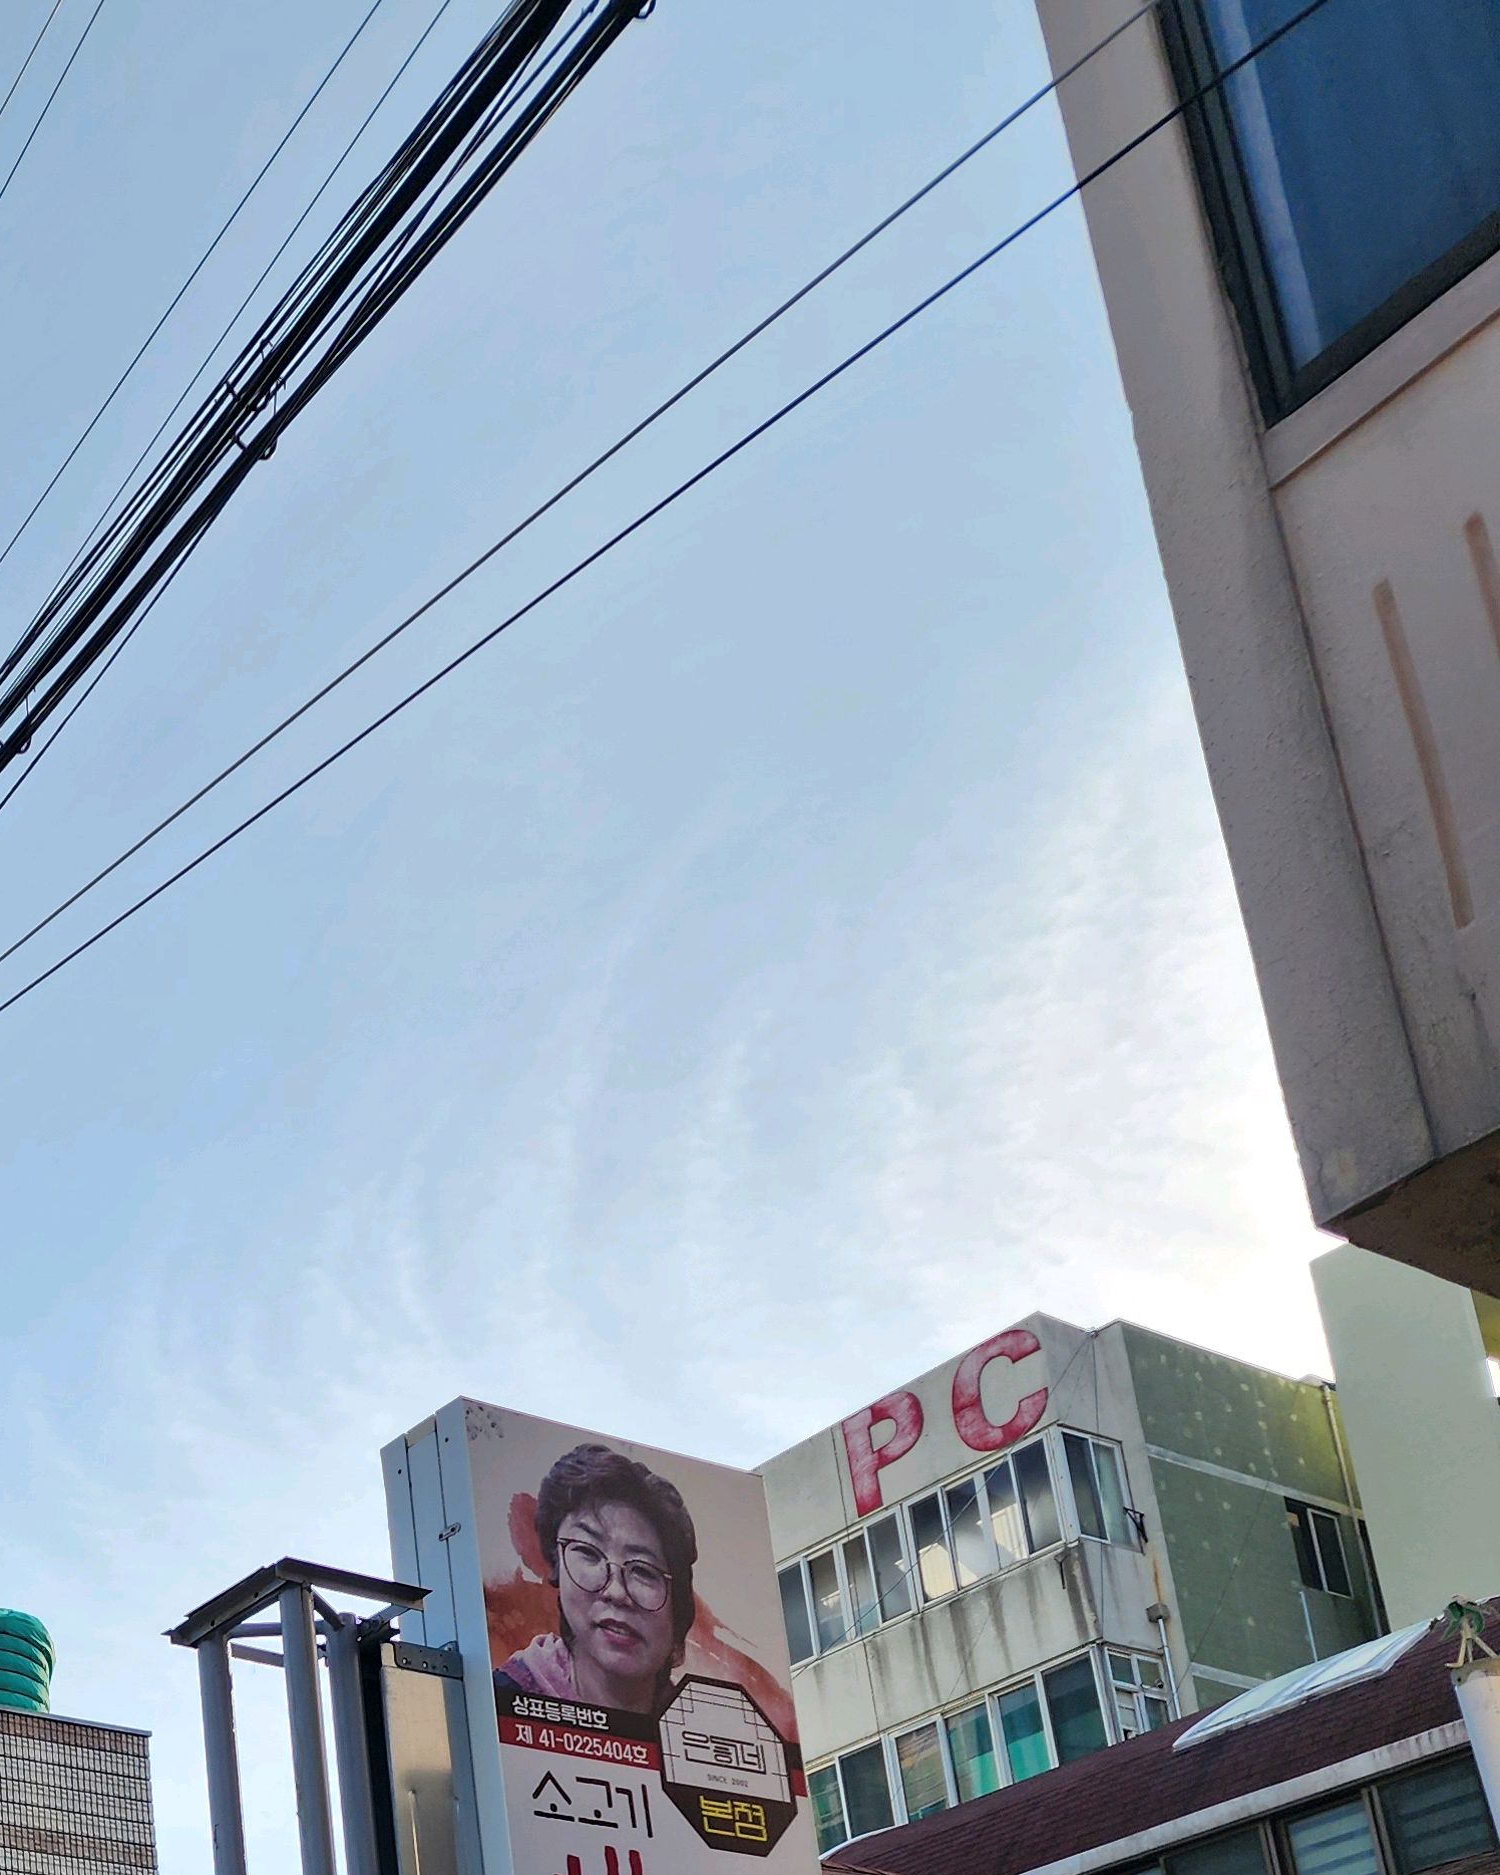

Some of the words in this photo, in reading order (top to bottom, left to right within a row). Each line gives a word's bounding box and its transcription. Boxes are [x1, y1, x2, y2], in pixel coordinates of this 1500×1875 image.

[841, 1328, 1050, 1518] PC
[511, 1694, 610, 1731] 상표등록번호
[515, 1723, 534, 1745] 제
[538, 1728, 650, 1766] 41-0225404호
[531, 1770, 654, 1839] 소고기
[699, 1794, 768, 1842] 본점
